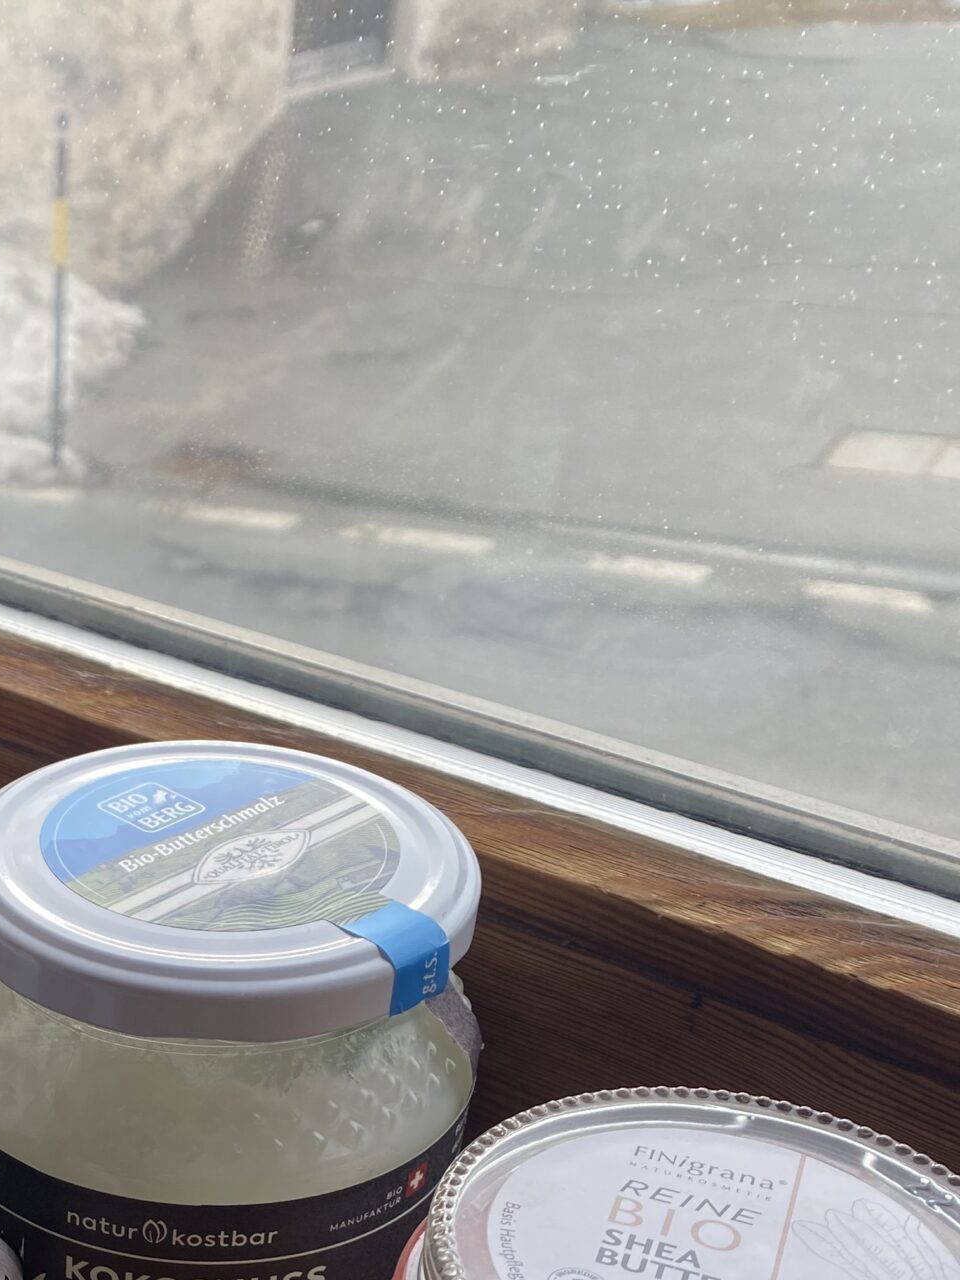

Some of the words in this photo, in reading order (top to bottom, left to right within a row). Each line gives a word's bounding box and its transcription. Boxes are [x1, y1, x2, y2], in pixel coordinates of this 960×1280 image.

[107, 793, 148, 814] BIO
[126, 805, 153, 819] vom
[137, 801, 197, 829] BERG
[118, 794, 286, 872] Bio-Butterschmalz
[386, 1185, 403, 1200] BIO
[629, 1161, 773, 1202] NATURKOSMETIK
[329, 1196, 402, 1232] MANUFAKTUR
[505, 1201, 521, 1232] Basis
[620, 1179, 763, 1226] REINE
[66, 1209, 138, 1241] natur
[171, 1227, 279, 1249] kostbar
[606, 1195, 742, 1252] BIO
[601, 1228, 701, 1269] SHEA
